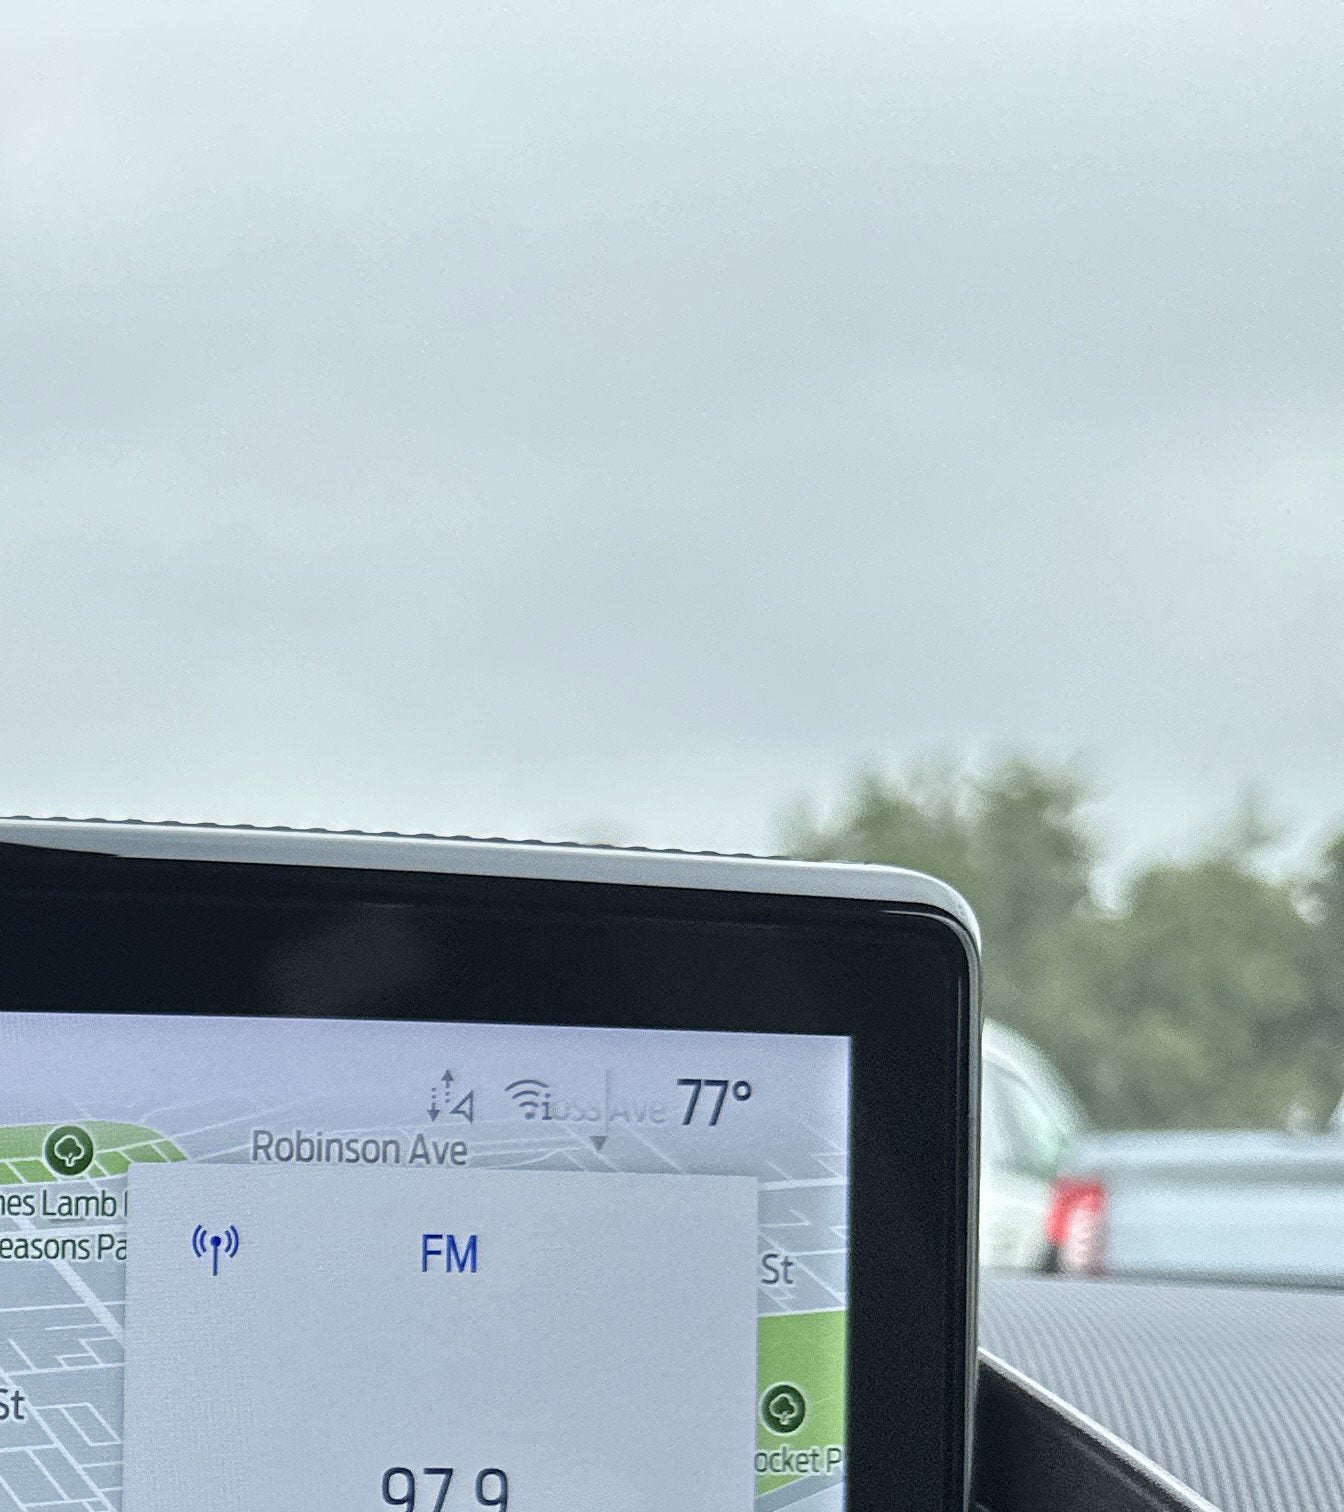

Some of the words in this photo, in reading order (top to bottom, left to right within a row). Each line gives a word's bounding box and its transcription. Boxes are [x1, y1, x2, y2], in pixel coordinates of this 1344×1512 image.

[252, 1128, 400, 1166] Robinson
[409, 1133, 468, 1167] Ave
[42, 1189, 117, 1218] Lamb
[421, 1234, 478, 1274] FM
[761, 1253, 795, 1286] St
